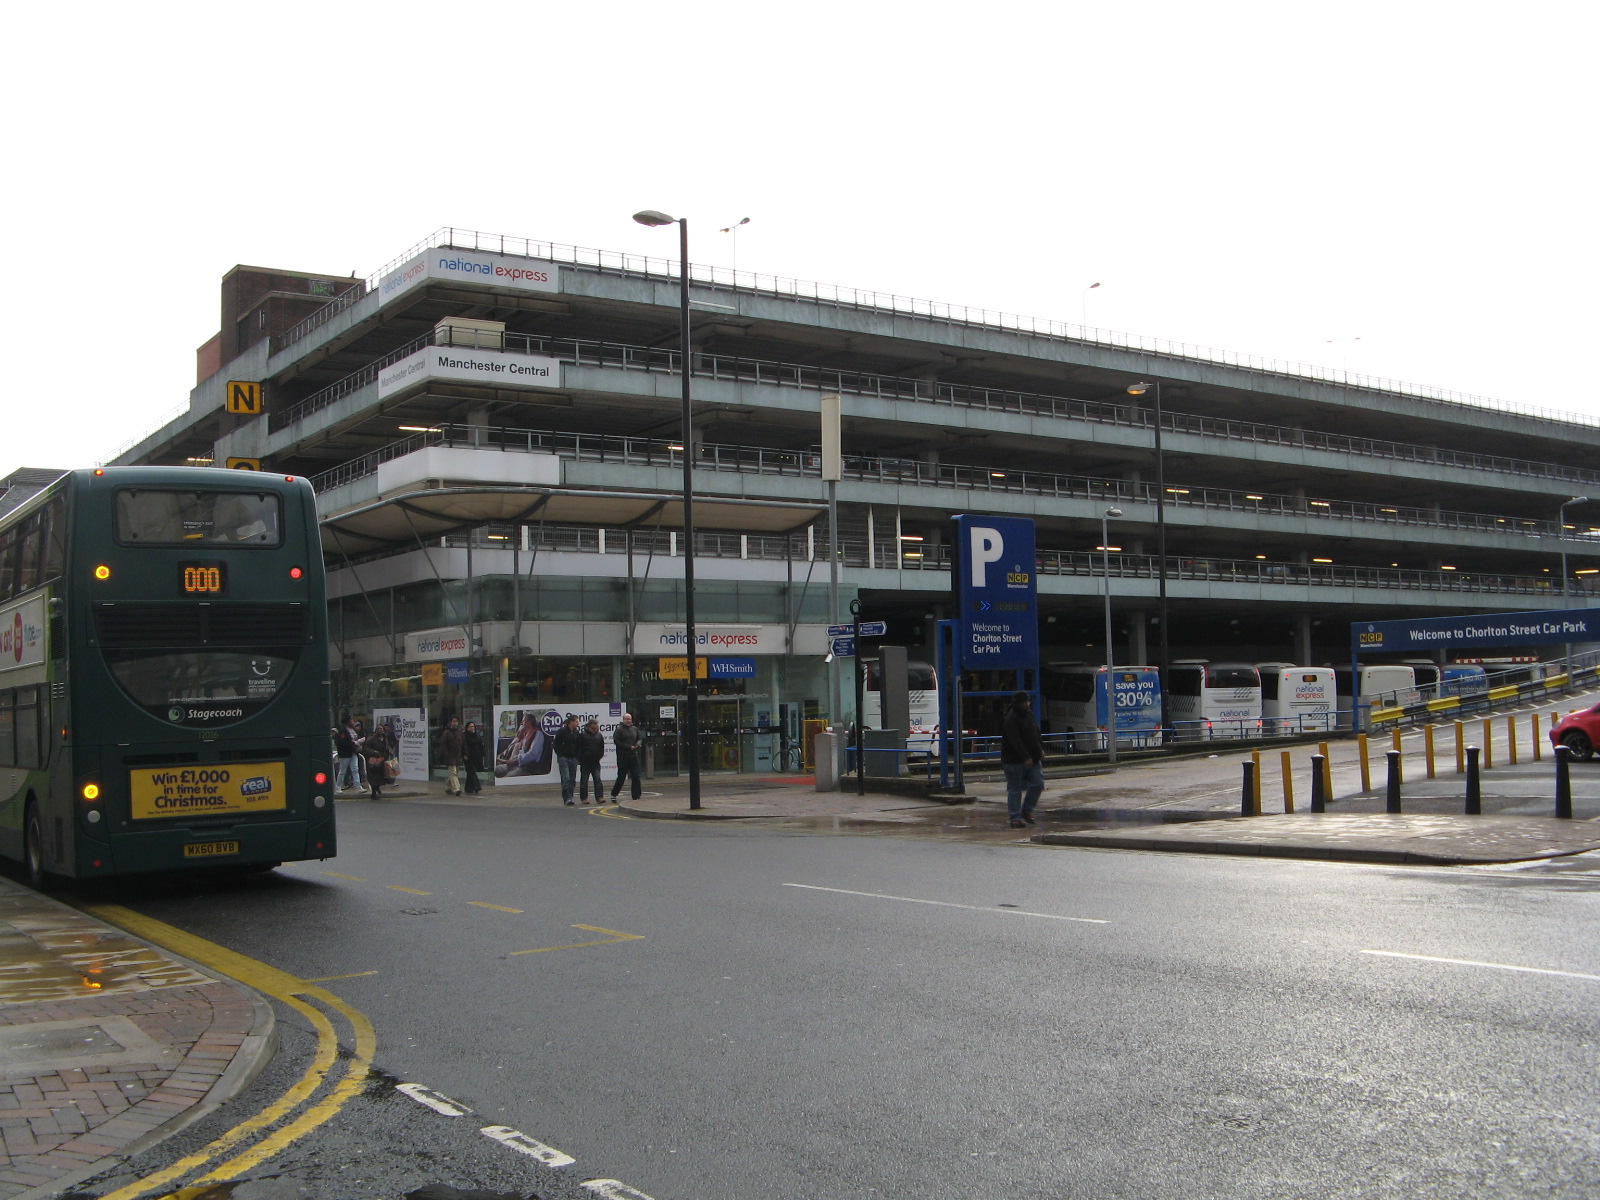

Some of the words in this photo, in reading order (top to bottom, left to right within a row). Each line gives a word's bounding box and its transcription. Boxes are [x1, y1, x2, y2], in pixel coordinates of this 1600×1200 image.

[403, 261, 425, 282] express
[439, 258, 493, 275] national
[495, 266, 548, 282] express
[438, 356, 506, 373] Manchester
[509, 363, 550, 377] Central
[381, 369, 408, 388] Manchester
[408, 358, 426, 375] Central
[233, 384, 255, 411] N
[970, 526, 1004, 588] P
[1008, 573, 1029, 583] NCP
[972, 623, 1002, 632] Welcome
[1003, 623, 1010, 632] to
[1409, 630, 1452, 640] Welcome
[1454, 629, 1464, 638] to
[1465, 626, 1508, 637] Chorlton
[1509, 624, 1541, 635] Street
[1543, 622, 1561, 633] Car
[1562, 621, 1587, 632] Park
[710, 634, 758, 648] express
[972, 633, 1002, 643] Chorlton
[1002, 634, 1022, 643] Street
[1360, 633, 1383, 642] NCP
[417, 636, 440, 653] national
[440, 638, 465, 654] express
[972, 644, 985, 654] Car
[986, 644, 1001, 654] Park
[712, 663, 753, 673] WHSmith
[1137, 681, 1154, 690] you
[1295, 685, 1324, 693] national
[1295, 692, 1325, 700] express
[187, 708, 243, 720] Stagecoach
[1220, 709, 1250, 717] national
[402, 718, 417, 729] Senior
[543, 715, 562, 726] £10
[402, 728, 426, 739] Coachcard
[152, 773, 178, 785] Win
[180, 770, 230, 785] £1,000
[163, 786, 174, 795] in
[176, 785, 201, 794] time
[202, 784, 218, 794] for
[242, 777, 269, 791] real
[154, 794, 228, 809] Christmas.
[187, 844, 214, 855] MX60
[215, 842, 235, 853] BVB
